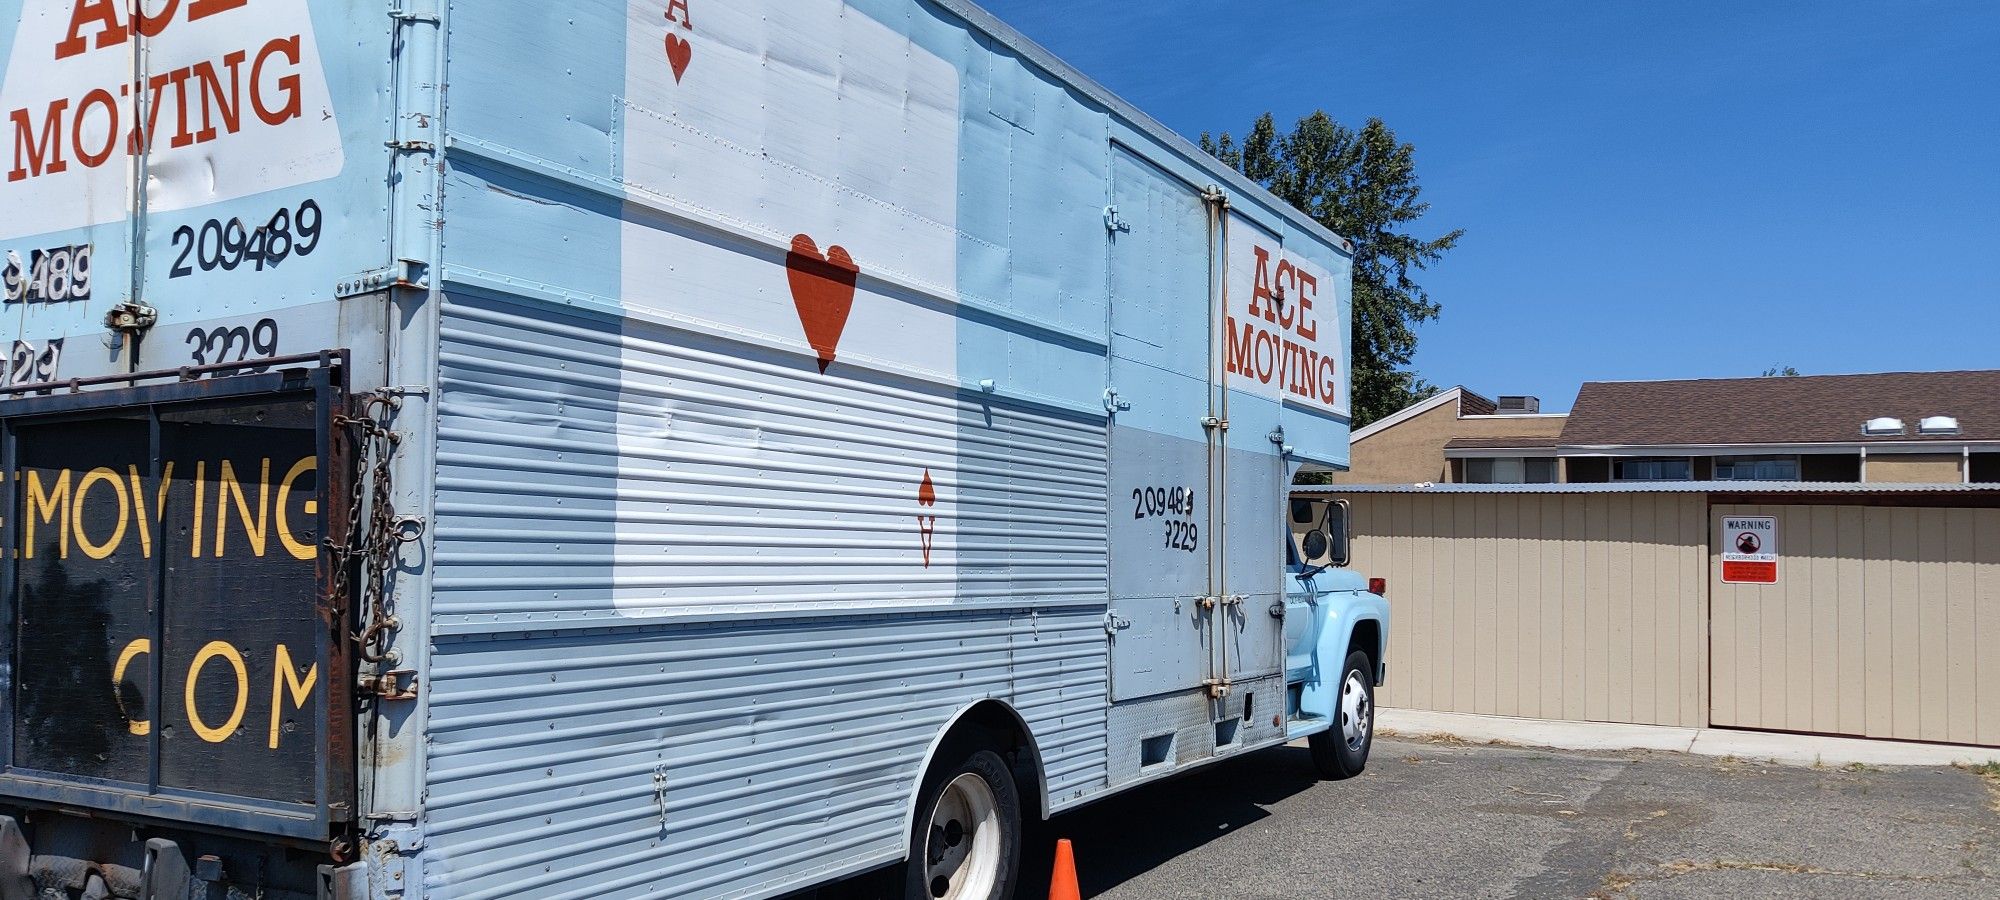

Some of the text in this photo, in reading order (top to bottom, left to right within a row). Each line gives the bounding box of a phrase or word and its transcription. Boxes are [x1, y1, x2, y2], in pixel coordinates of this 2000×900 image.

[7, 34, 301, 182] MOVING
[168, 198, 322, 279] 209489
[1248, 244, 1317, 343] ACE
[1226, 316, 1335, 406] MOVING
[25, 455, 318, 560] MOVING
[1165, 519, 1198, 553] 3229
[1727, 520, 1771, 530] WARNING
